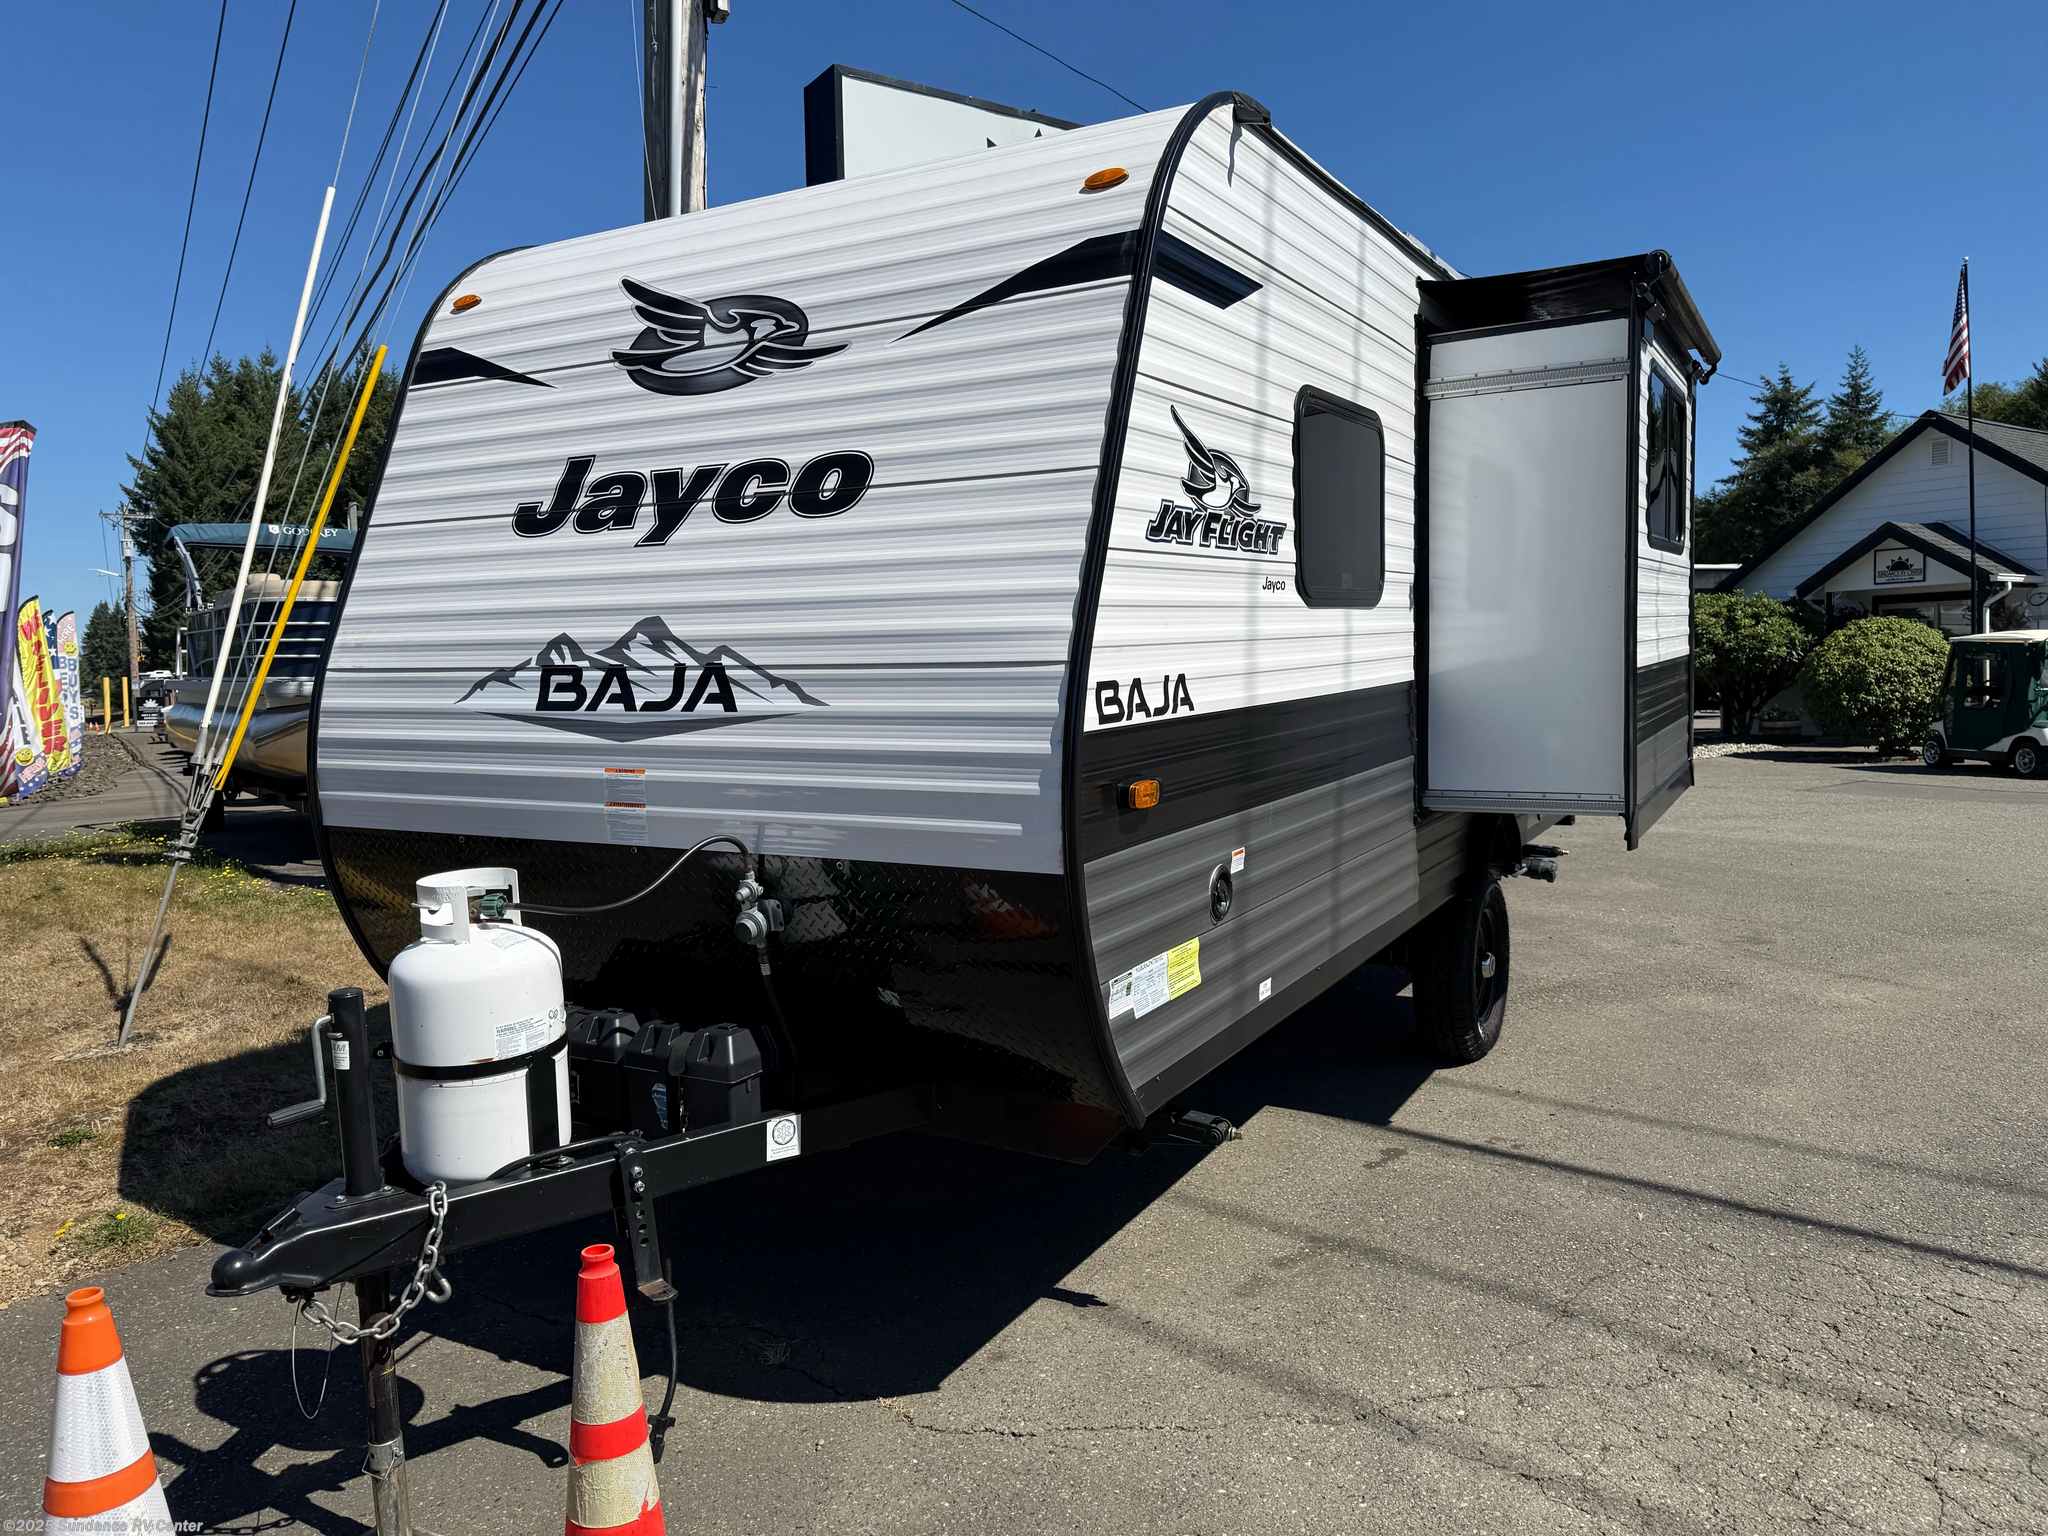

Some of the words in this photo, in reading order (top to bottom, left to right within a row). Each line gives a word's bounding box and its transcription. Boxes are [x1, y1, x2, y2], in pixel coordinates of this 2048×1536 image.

[511, 450, 875, 548] Jayco
[283, 526, 338, 538] GODEY
[1145, 499, 1205, 546] JAY
[1199, 510, 1287, 555] FLIGHT
[1262, 576, 1286, 593] Jayco
[20, 609, 41, 641] WE
[57, 623, 75, 645] HERE
[67, 658, 80, 720] BUYS
[535, 663, 738, 712] BAJA
[1095, 673, 1195, 725] BAJA
